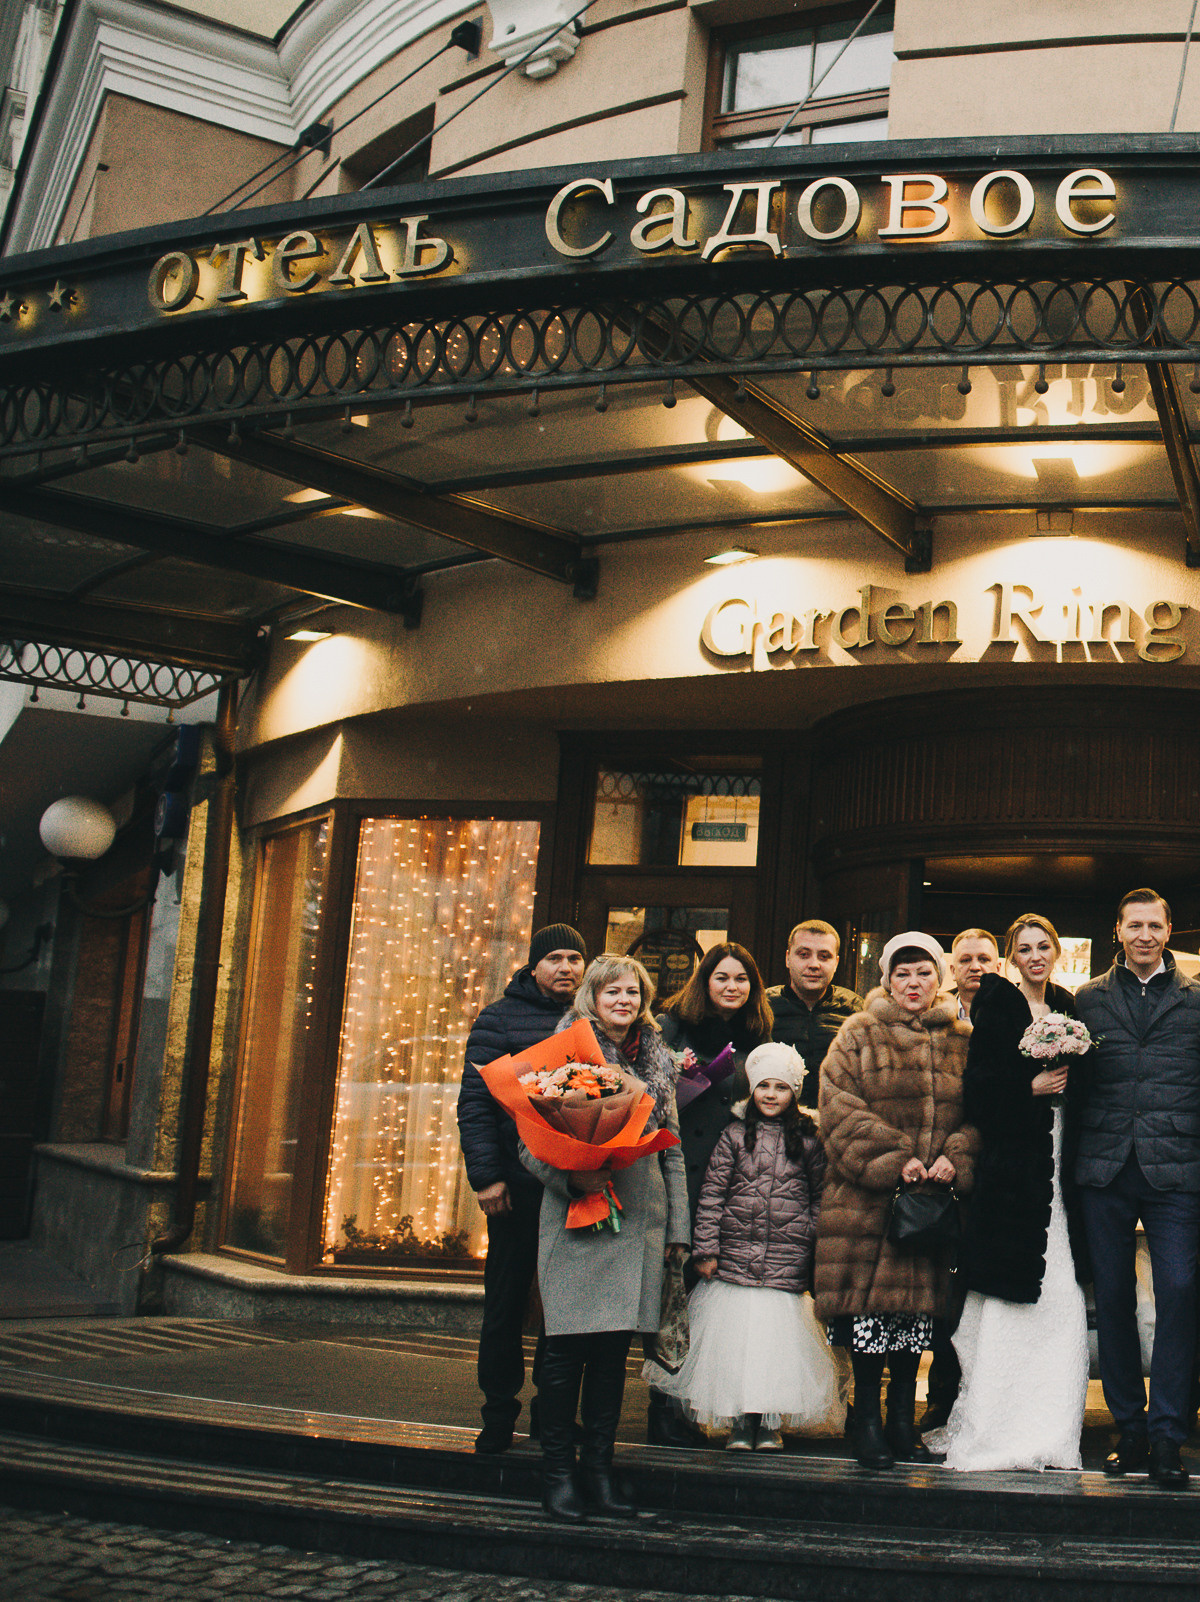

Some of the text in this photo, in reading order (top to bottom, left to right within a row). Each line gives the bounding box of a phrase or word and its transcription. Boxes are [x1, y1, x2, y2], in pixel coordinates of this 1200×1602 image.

[545, 168, 1117, 261] Садовое
[699, 584, 963, 656] Garden
[984, 582, 1189, 663] Ring
